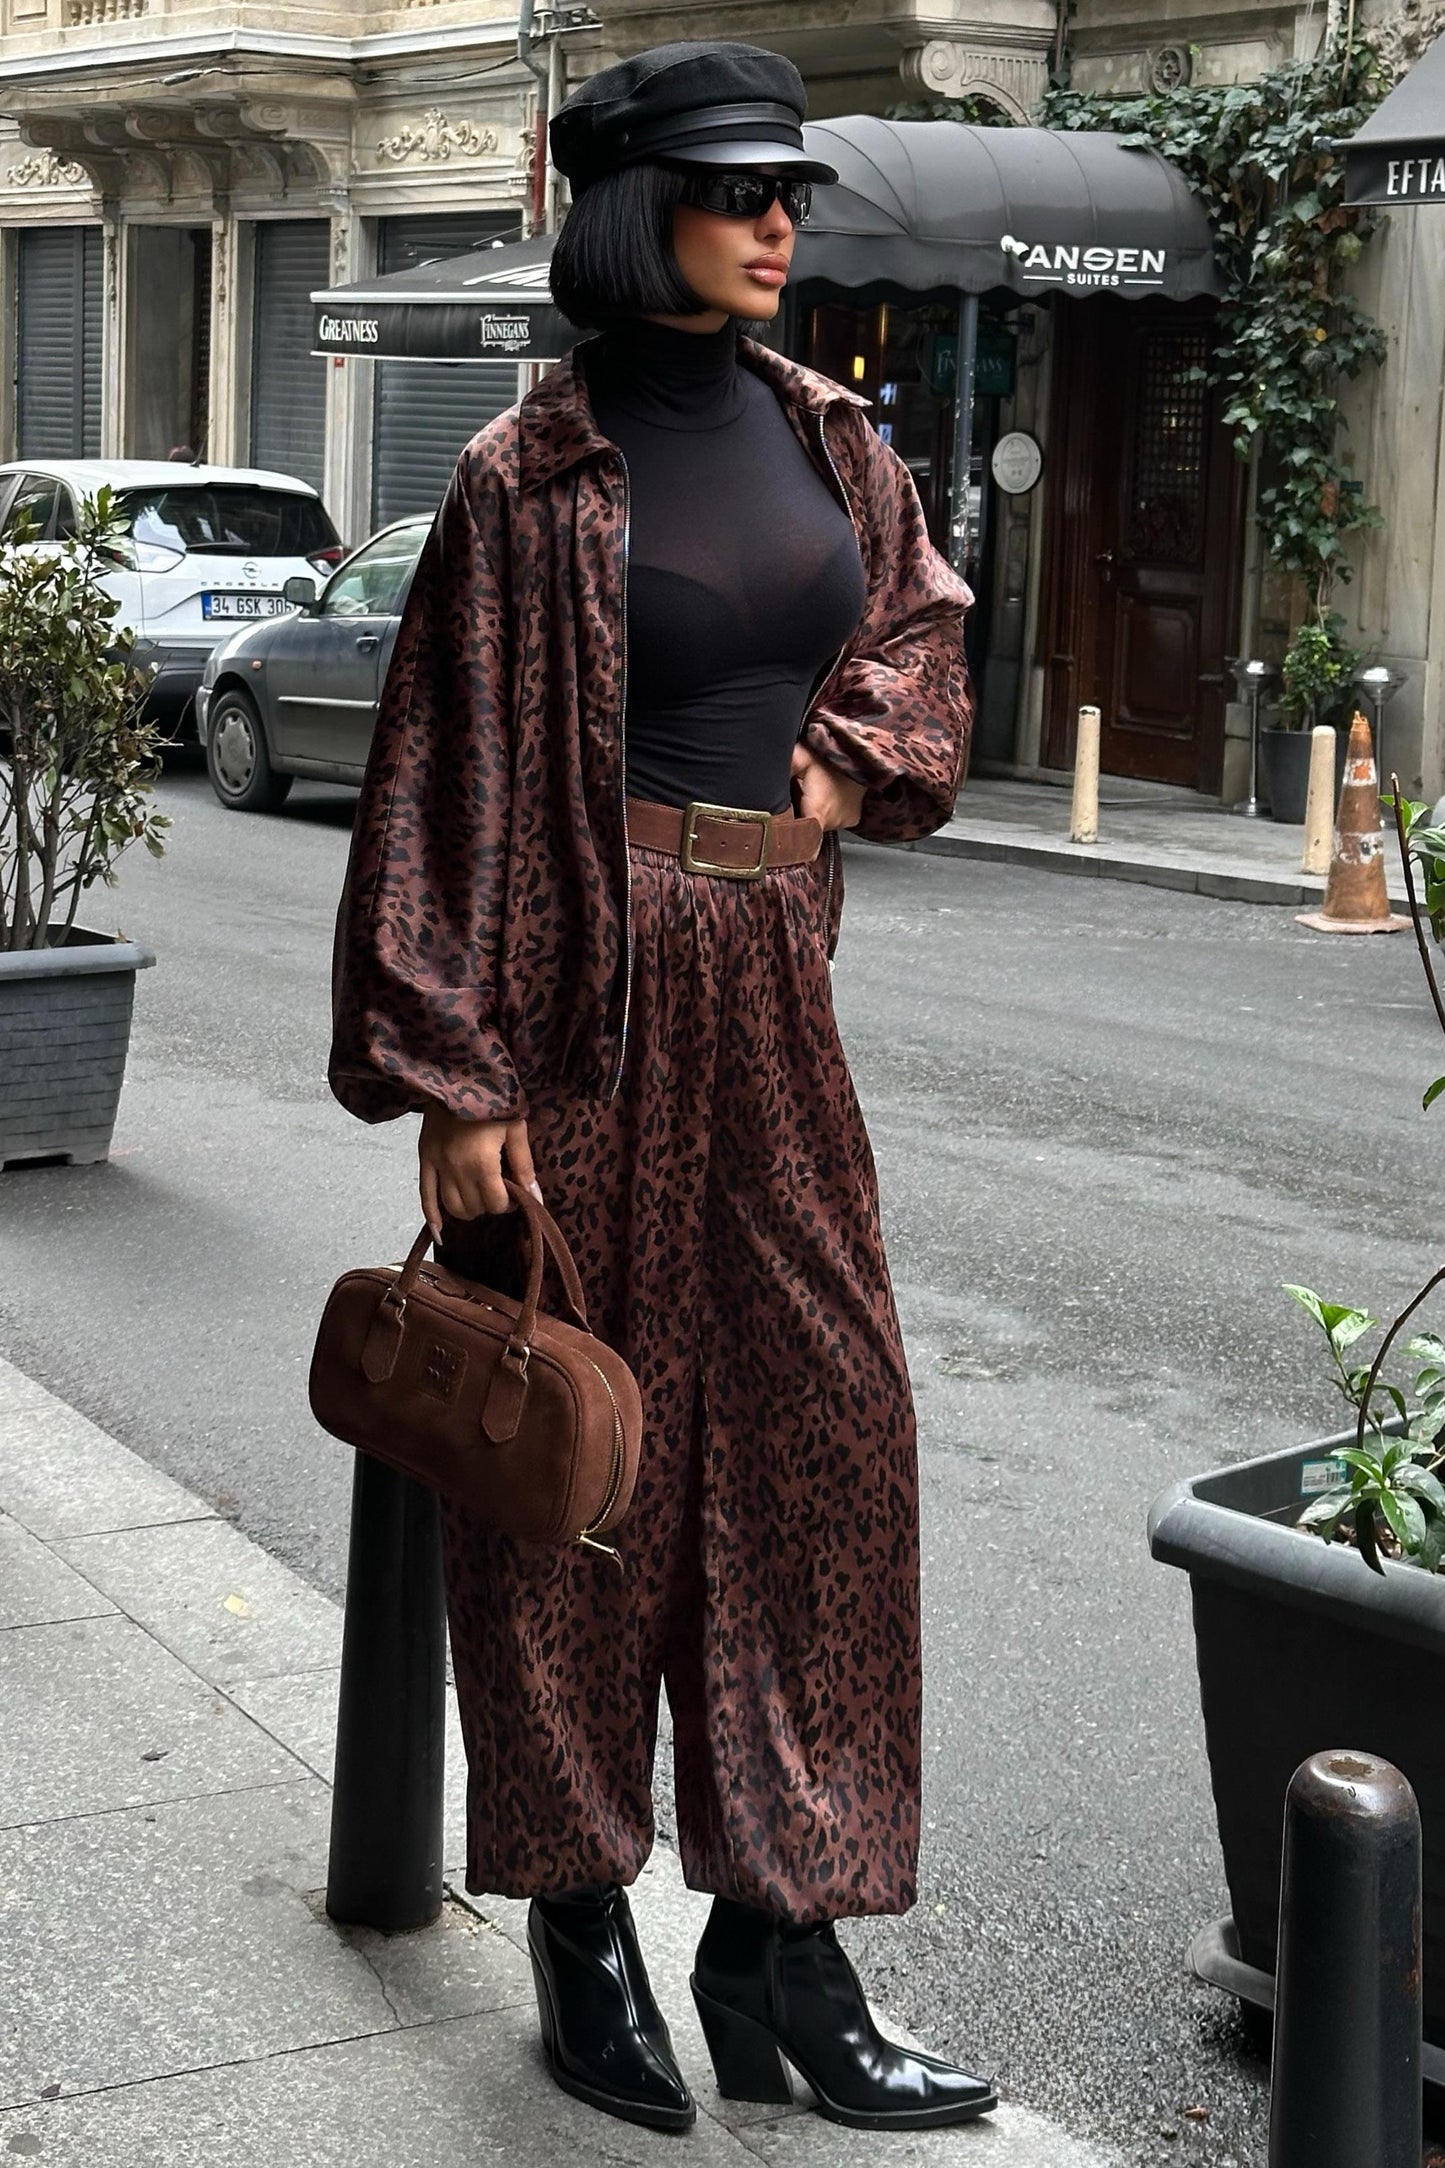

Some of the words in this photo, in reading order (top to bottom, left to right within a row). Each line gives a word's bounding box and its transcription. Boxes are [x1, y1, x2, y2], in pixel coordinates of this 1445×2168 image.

[1386, 157, 1445, 195] EFTA
[1067, 273, 1120, 286] SUITES
[319, 315, 378, 343] GREATNESS
[213, 597, 229, 614] 34
[237, 597, 261, 614] GSK
